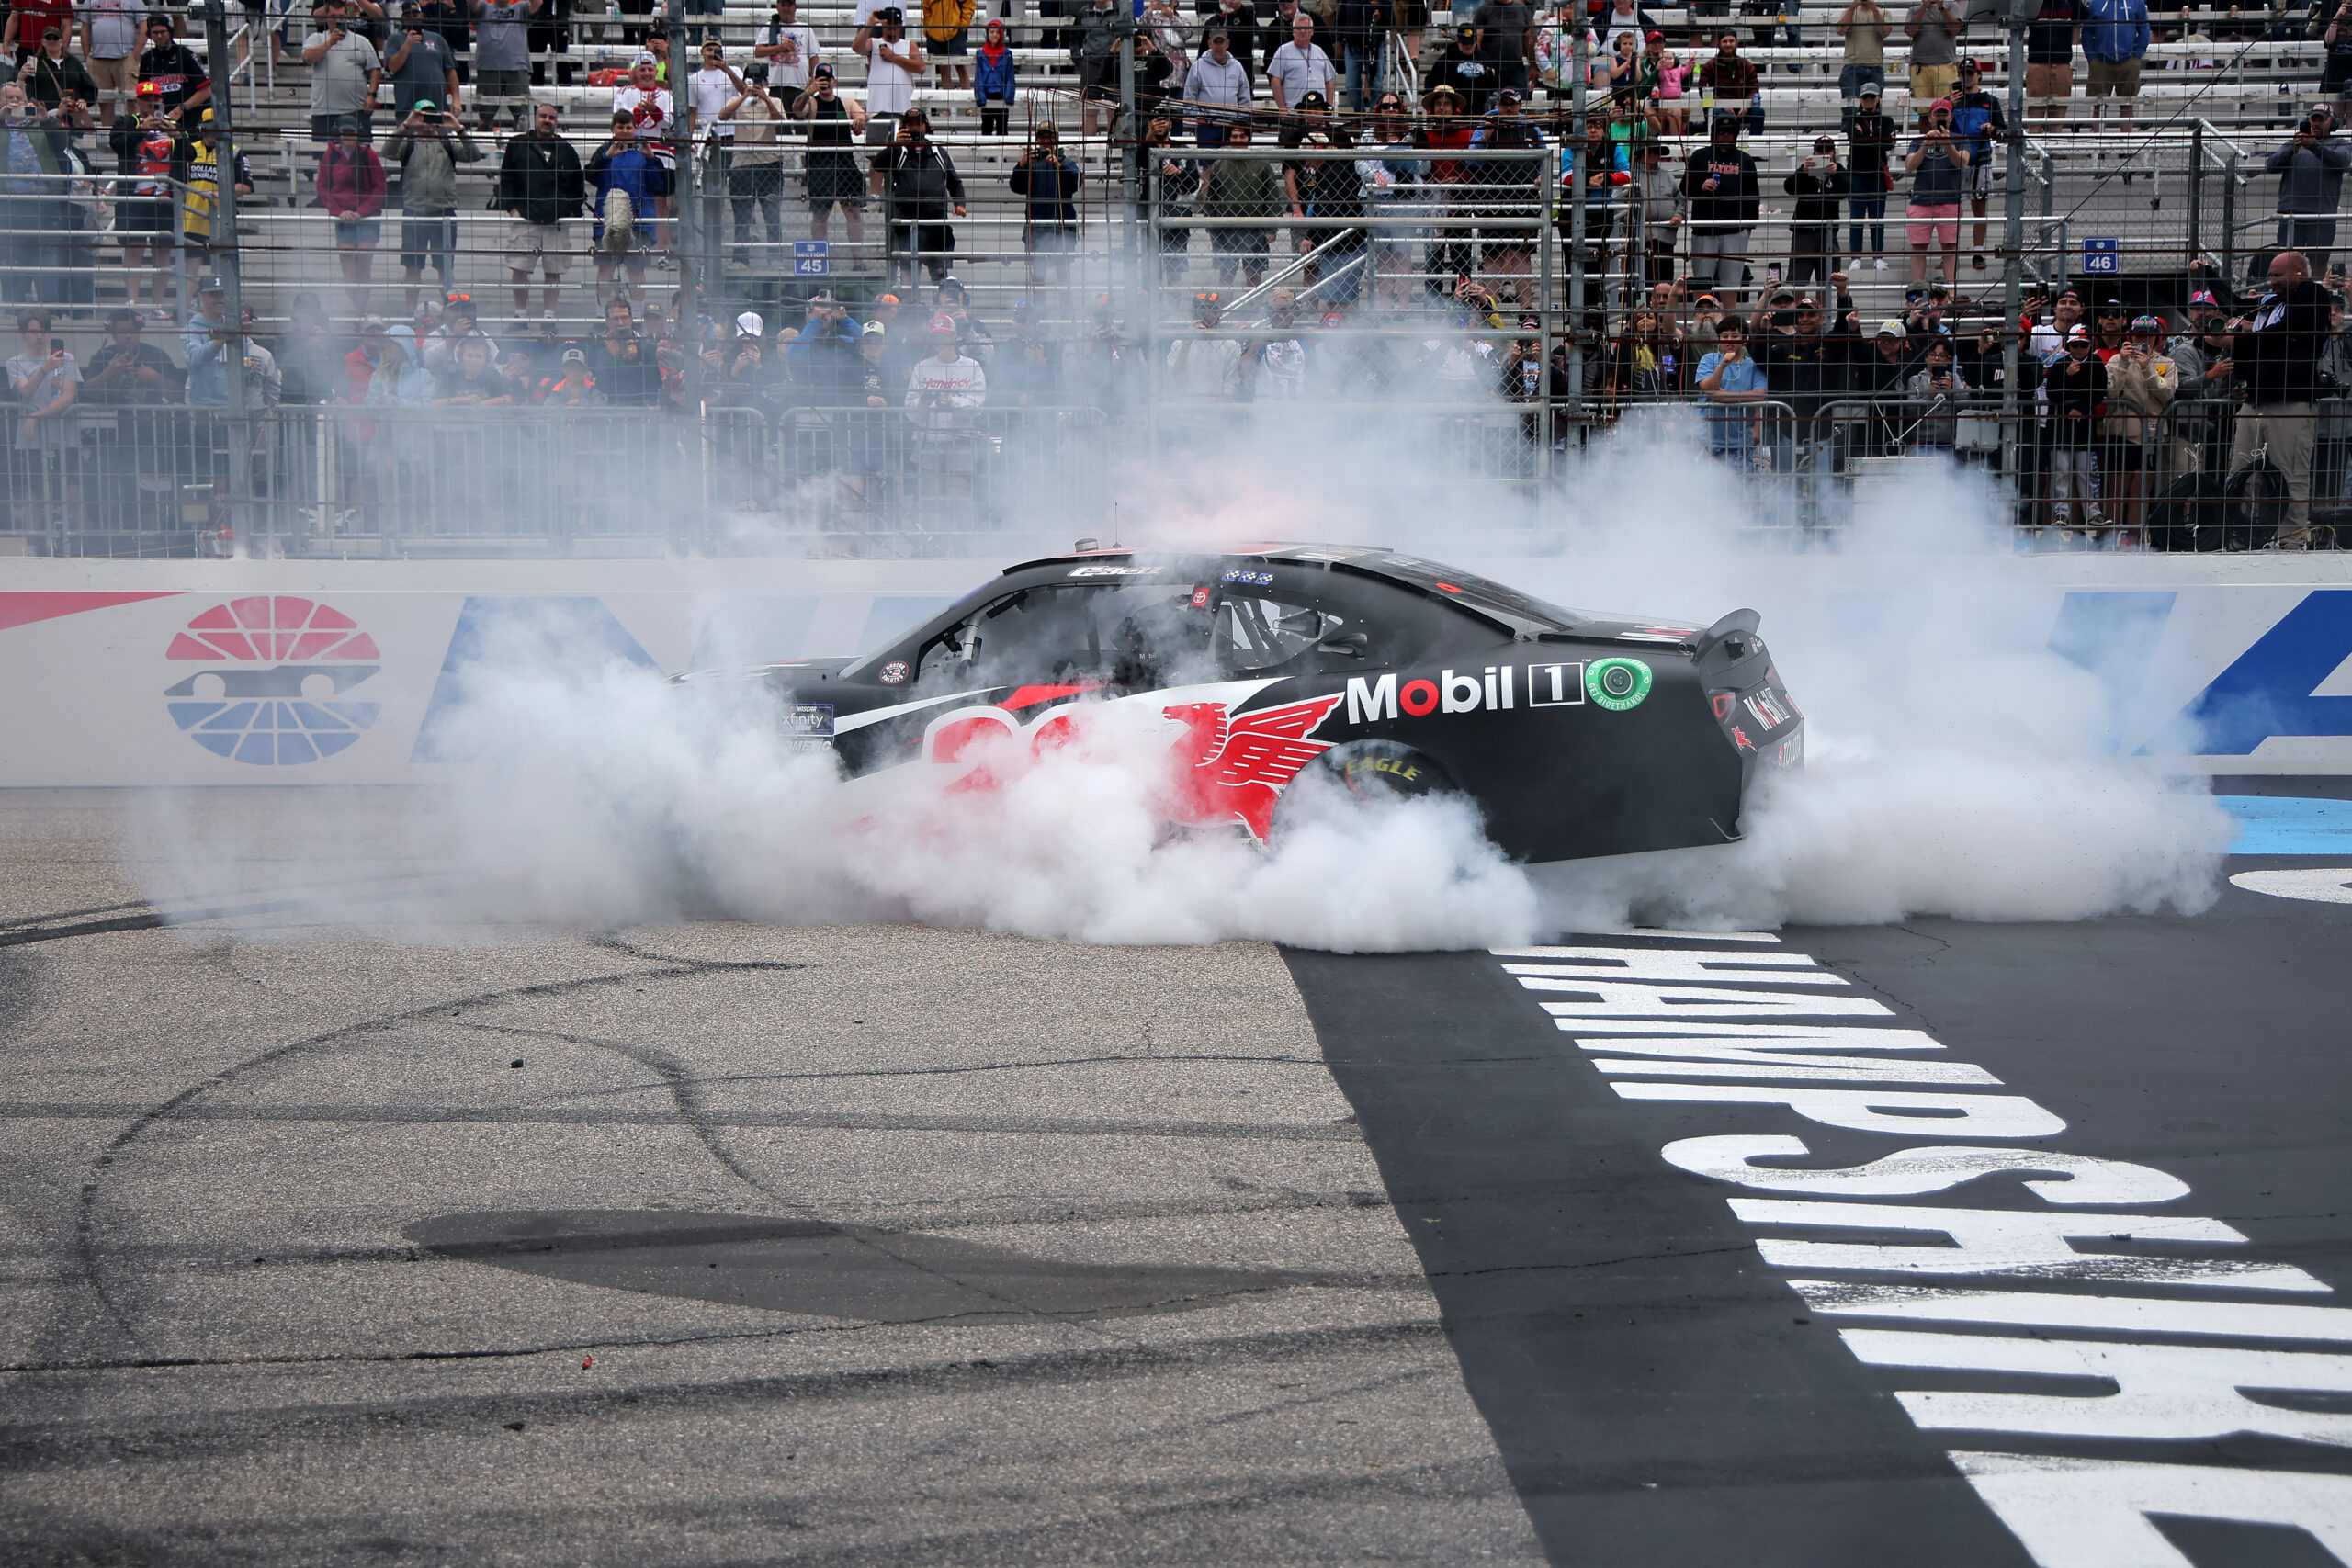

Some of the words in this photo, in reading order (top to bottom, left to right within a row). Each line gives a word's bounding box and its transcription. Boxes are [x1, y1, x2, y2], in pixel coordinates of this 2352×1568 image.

[288, 88, 296, 96] 3
[1707, 163, 1740, 175] FLYERS
[800, 259, 822, 272] 45
[2089, 256, 2111, 269] 46
[921, 377, 971, 389] Hendrick
[886, 662, 906, 671] NASCAR
[1346, 664, 1514, 725] Mobil
[1588, 682, 1600, 697] GET
[1597, 691, 1645, 710] BIOETHANOL
[782, 713, 824, 728] xfinity
[1344, 756, 1422, 782] EAGLE
